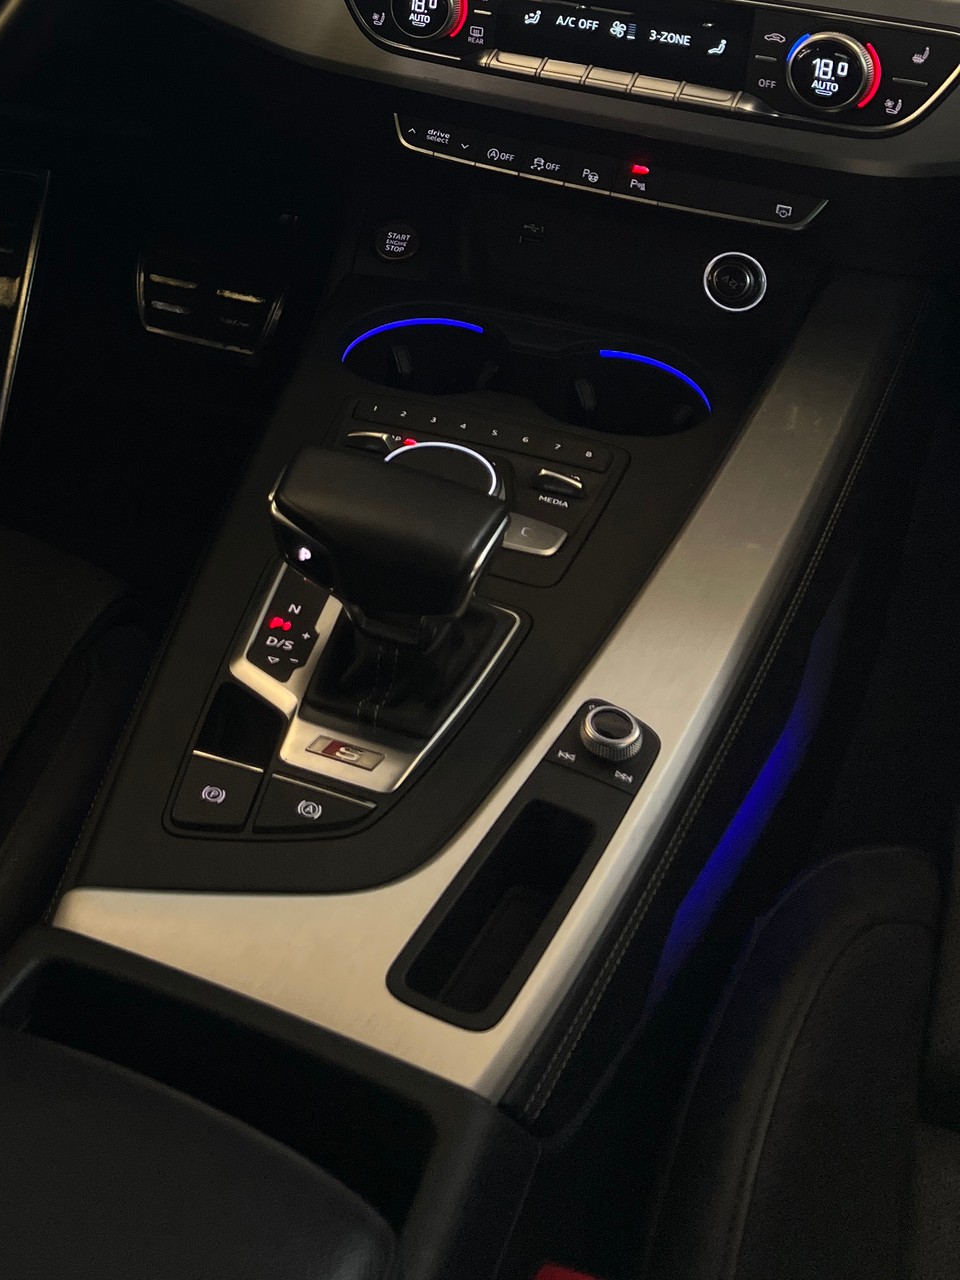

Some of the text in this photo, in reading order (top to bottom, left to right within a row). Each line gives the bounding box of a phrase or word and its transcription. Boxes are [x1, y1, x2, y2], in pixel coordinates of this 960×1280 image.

[408, 12, 431, 24] AUTO
[555, 15, 600, 31] A/C OFF
[467, 36, 484, 45] REAR
[648, 29, 692, 47] 3-ZONE
[758, 78, 777, 89] OFF
[810, 79, 839, 92] AUTO
[427, 128, 451, 139] drive
[426, 134, 449, 145] select
[499, 152, 516, 161] OFF
[545, 162, 561, 172] OFF
[387, 231, 411, 241] START
[385, 244, 405, 253] STOP
[538, 495, 569, 508] MEDIA
[288, 603, 301, 615] N
[266, 636, 294, 651] D/S
